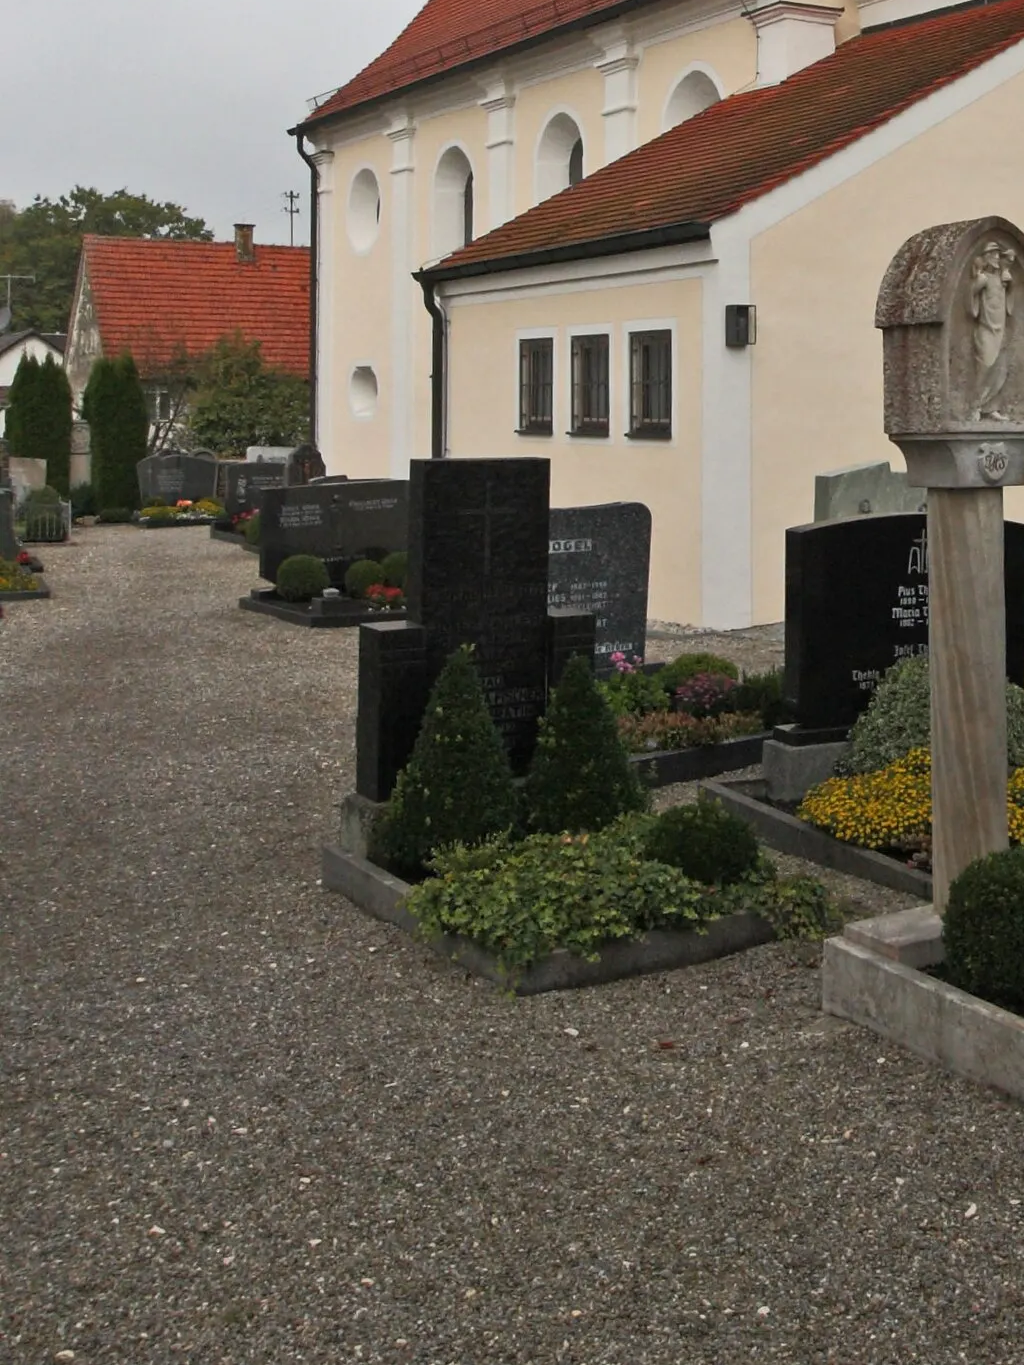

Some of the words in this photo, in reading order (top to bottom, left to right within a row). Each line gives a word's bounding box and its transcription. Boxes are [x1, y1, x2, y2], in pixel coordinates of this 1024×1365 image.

[551, 540, 591, 552] OGEL
[917, 584, 929, 595] Th
[892, 607, 920, 619] Maria
